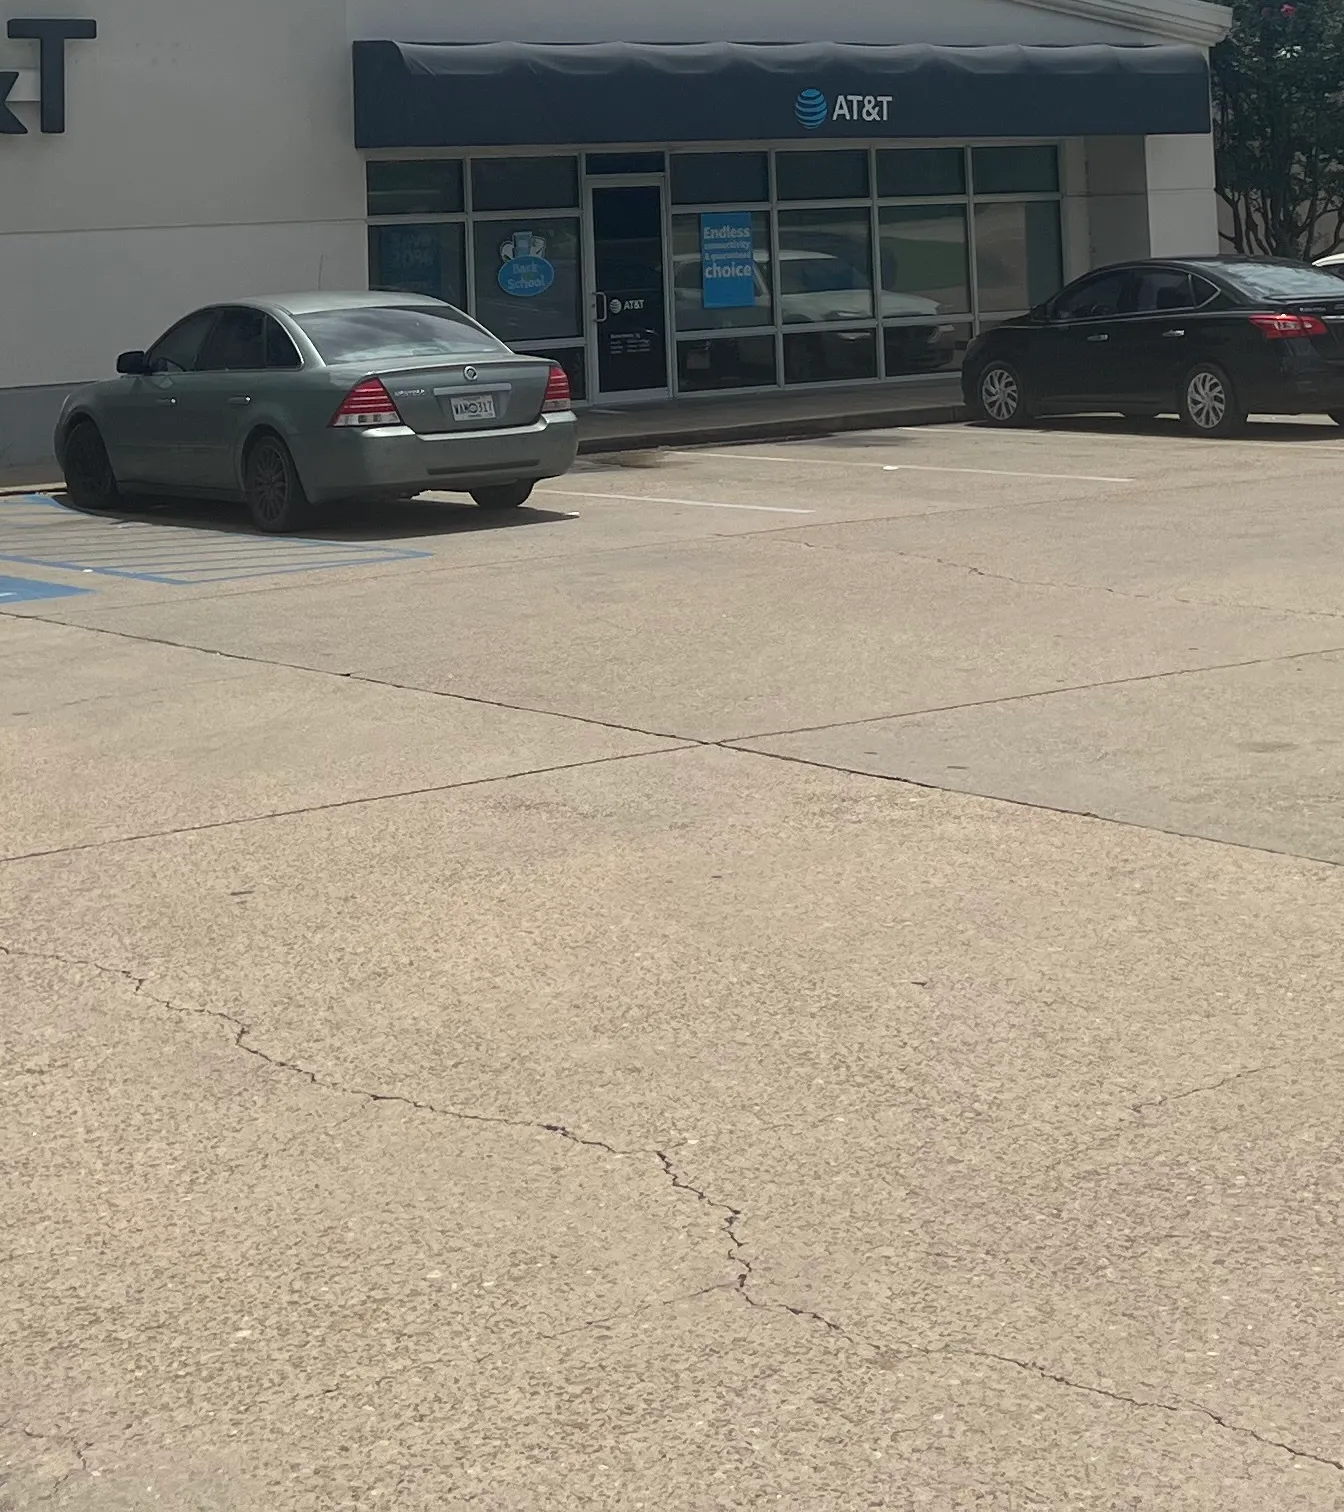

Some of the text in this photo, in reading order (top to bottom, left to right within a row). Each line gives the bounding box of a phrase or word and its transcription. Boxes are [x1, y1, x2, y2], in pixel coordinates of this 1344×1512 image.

[832, 94, 893, 122] AT&T
[703, 225, 750, 239] Endless
[511, 261, 538, 274] Back
[705, 261, 752, 278] choice
[507, 274, 546, 290] School
[623, 299, 645, 310] AT&T
